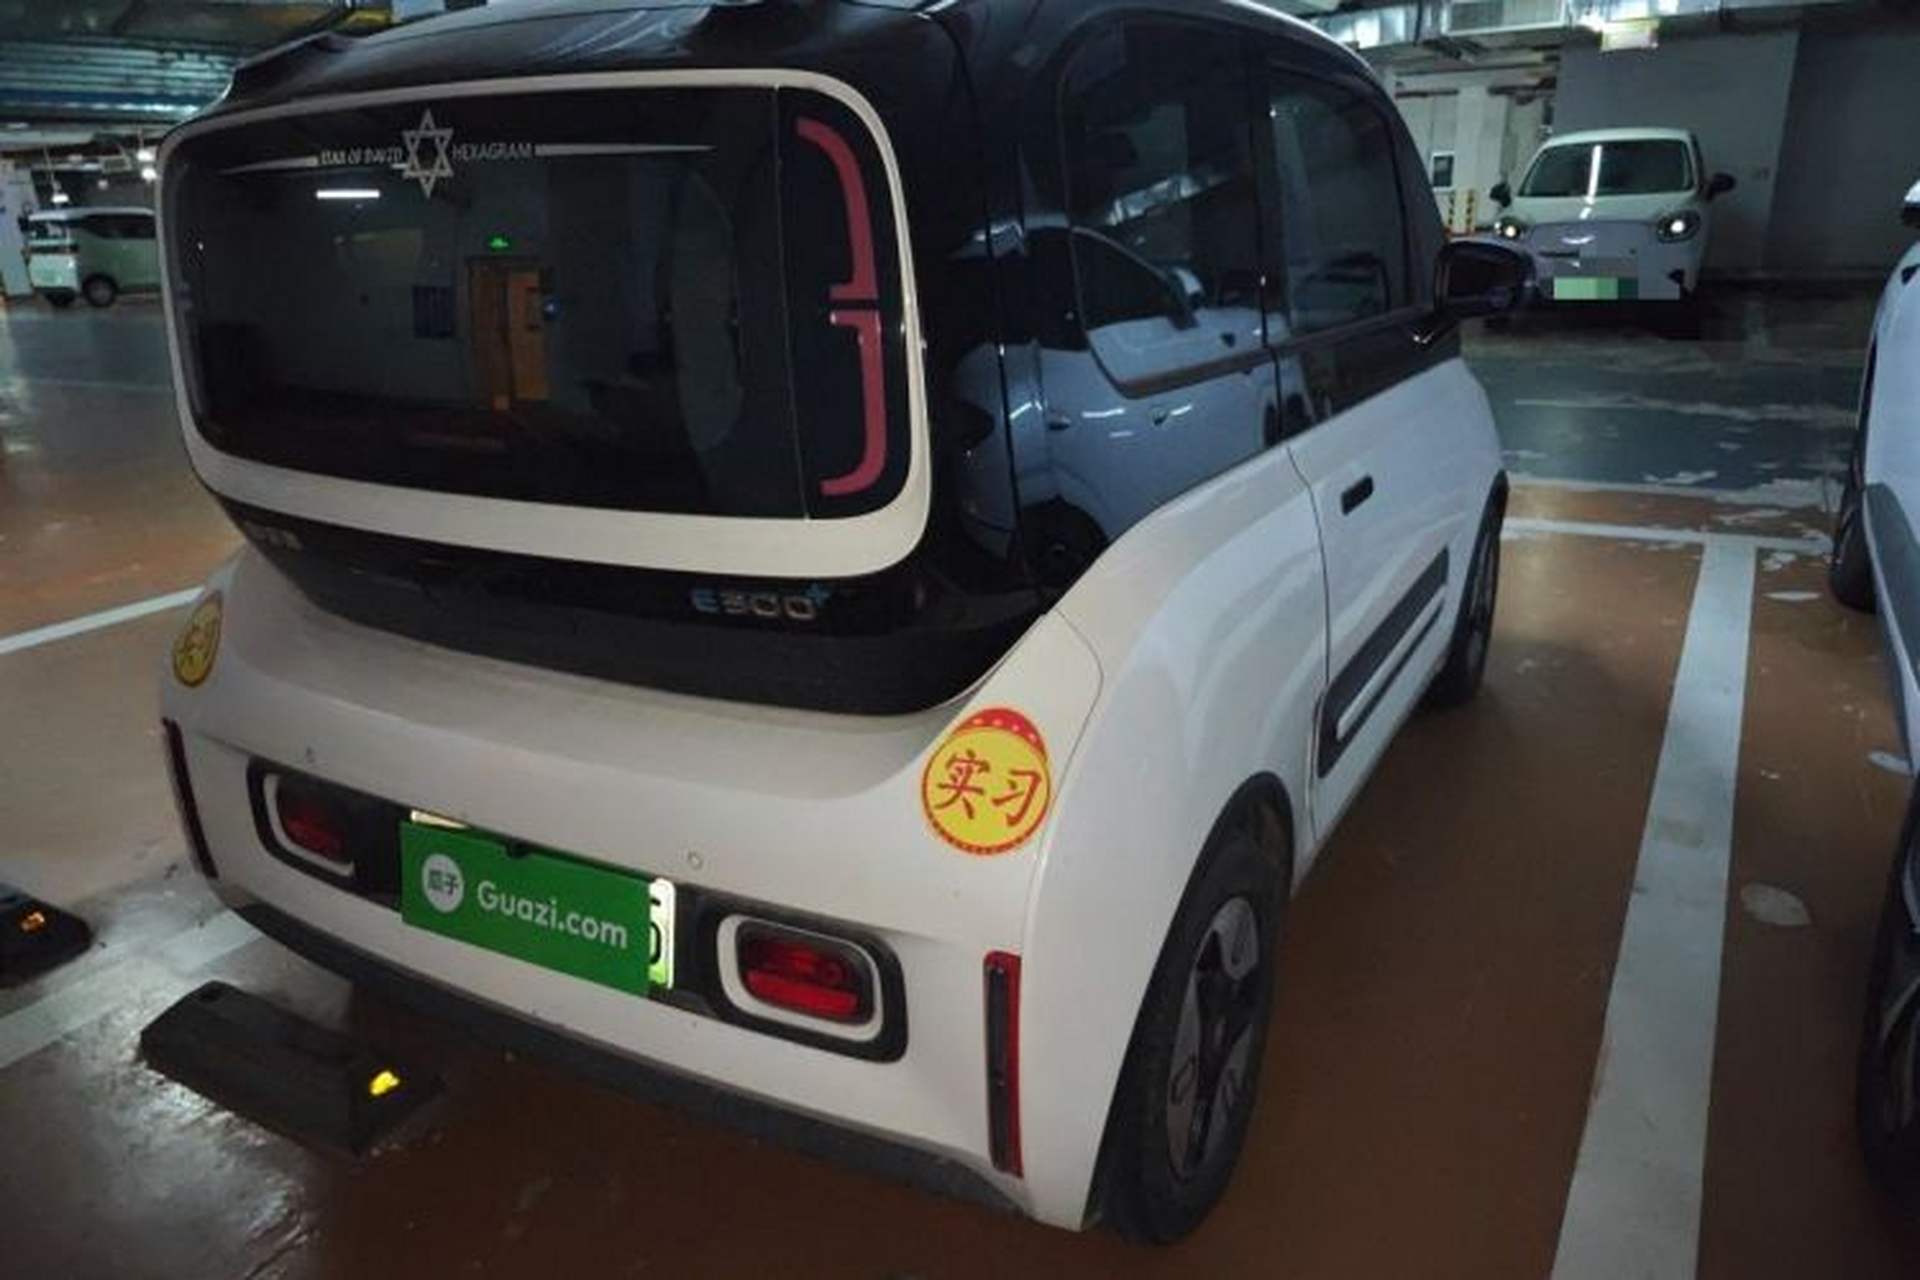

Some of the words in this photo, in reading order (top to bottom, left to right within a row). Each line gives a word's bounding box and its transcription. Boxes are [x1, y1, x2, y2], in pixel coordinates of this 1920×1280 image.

[452, 143, 533, 160] HEXAGRAM
[934, 749, 1042, 826] 实习
[477, 880, 628, 949] Guazi.com
